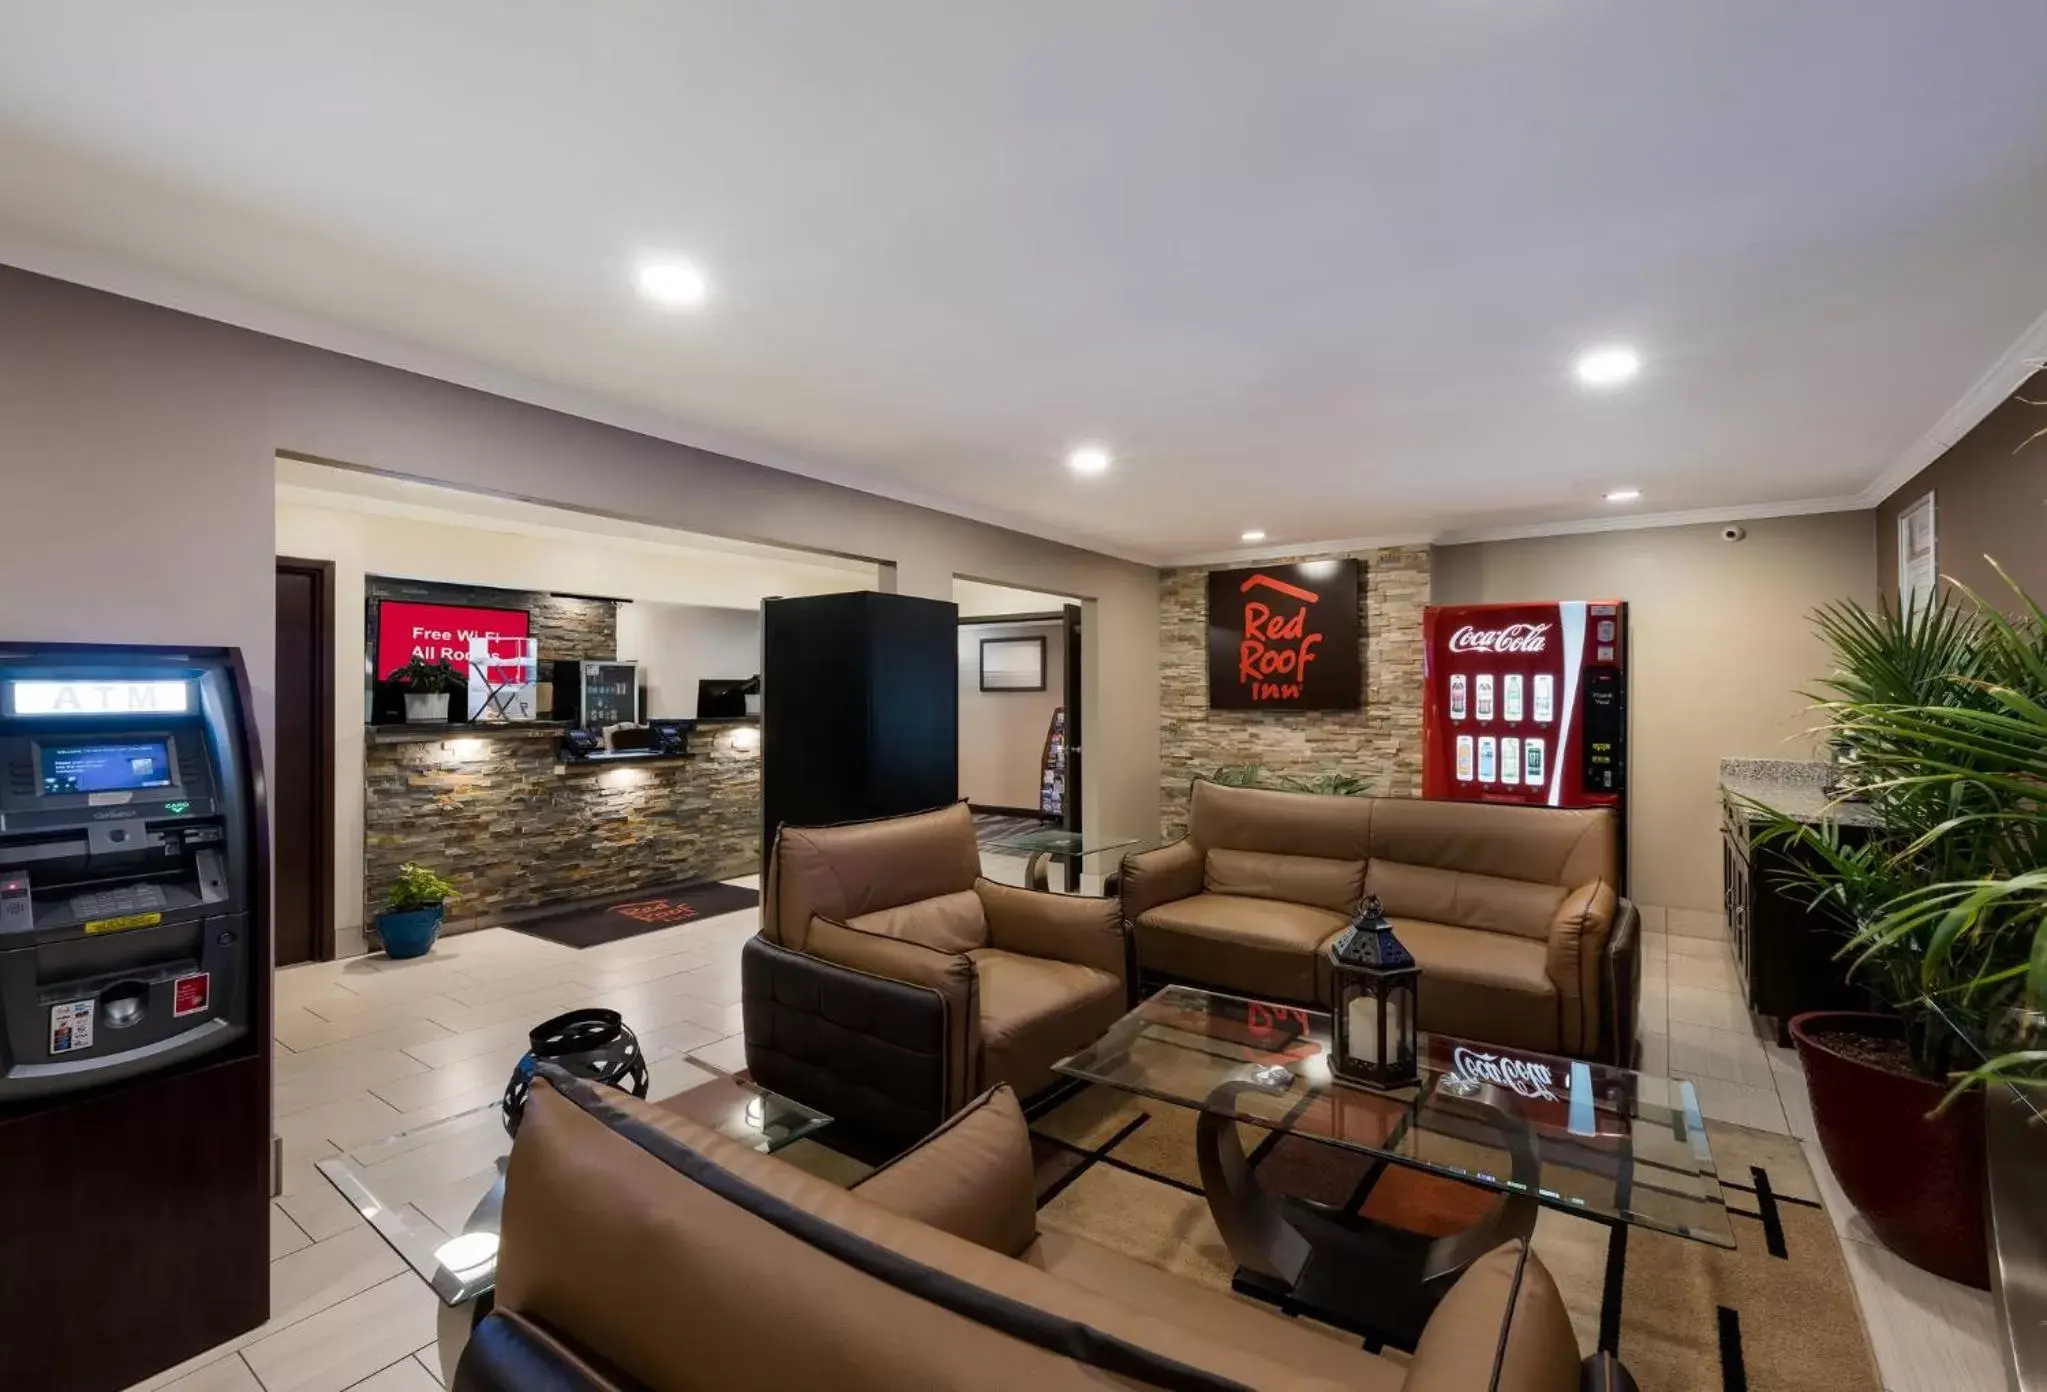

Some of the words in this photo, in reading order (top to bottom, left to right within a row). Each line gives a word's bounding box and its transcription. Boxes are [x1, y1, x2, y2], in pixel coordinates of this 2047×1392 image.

[412, 627, 452, 640] Free
[1245, 602, 1307, 642] Red
[1448, 623, 1553, 652] Coca-Cola
[412, 646, 436, 660] All
[441, 648, 500, 661] Roos
[1239, 633, 1323, 683] Roof
[53, 686, 157, 709] ATM
